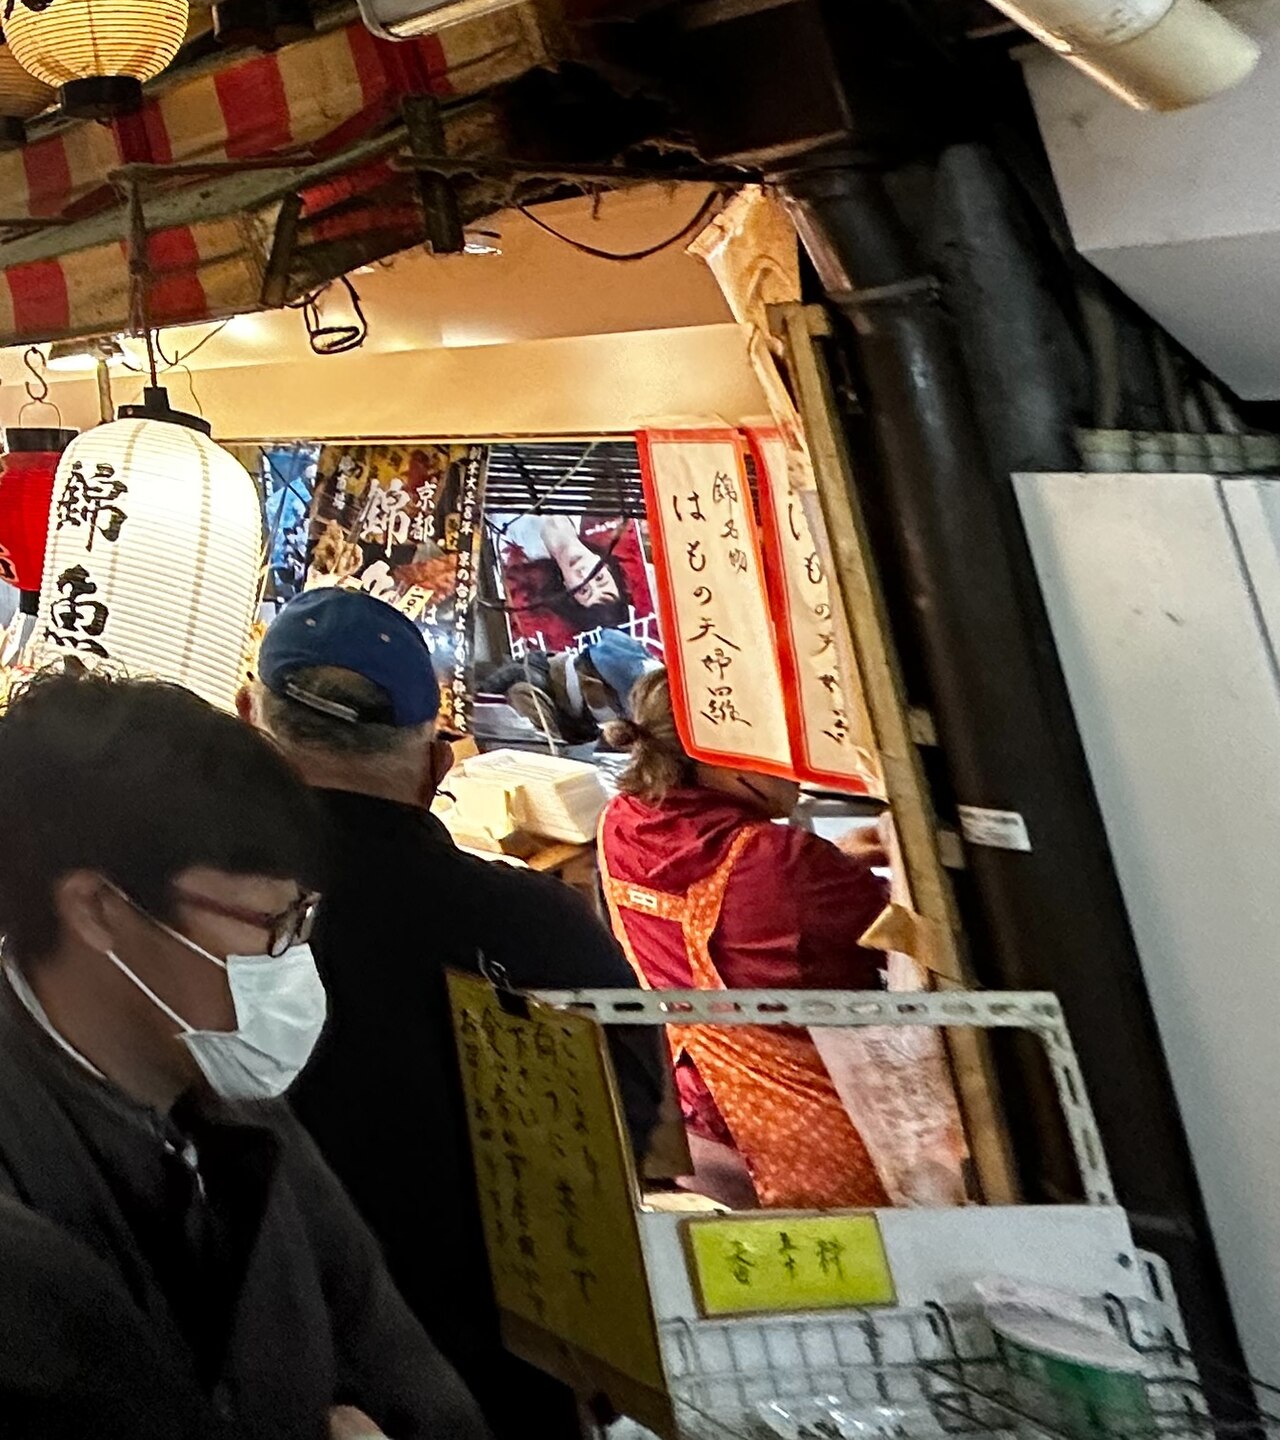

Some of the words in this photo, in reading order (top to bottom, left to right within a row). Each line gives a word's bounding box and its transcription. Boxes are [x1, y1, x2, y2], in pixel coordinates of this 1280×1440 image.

[44, 460, 128, 672] 錦魚
[410, 480, 438, 540] 京都
[672, 491, 753, 728] はもの天婦羅
